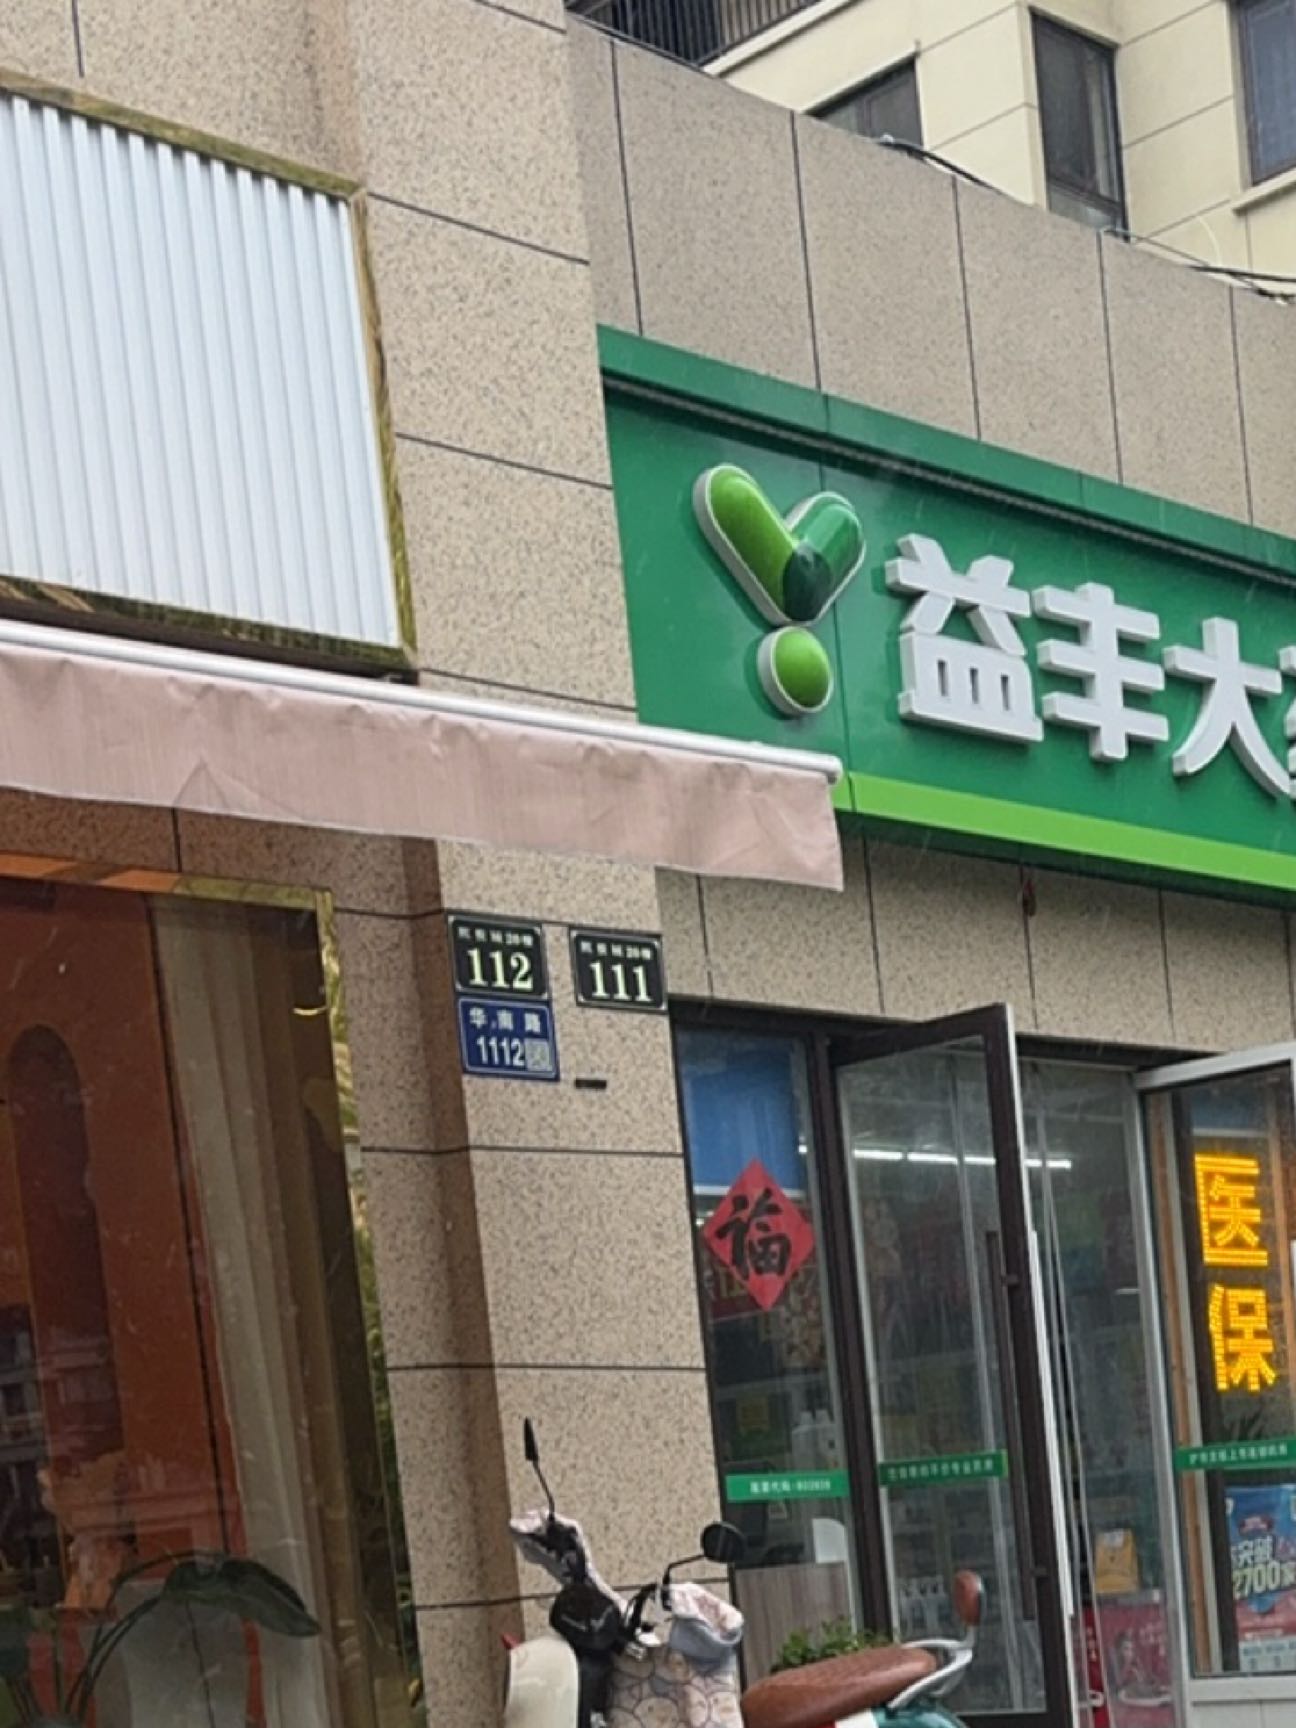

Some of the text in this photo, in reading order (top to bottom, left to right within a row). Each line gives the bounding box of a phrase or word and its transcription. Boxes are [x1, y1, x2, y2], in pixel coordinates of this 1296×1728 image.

[467, 947, 534, 991] 112
[590, 960, 653, 1002] 111
[477, 1036, 526, 1067] 1112
[715, 1187, 792, 1281] 福
[1194, 1153, 1277, 1393] 医保
